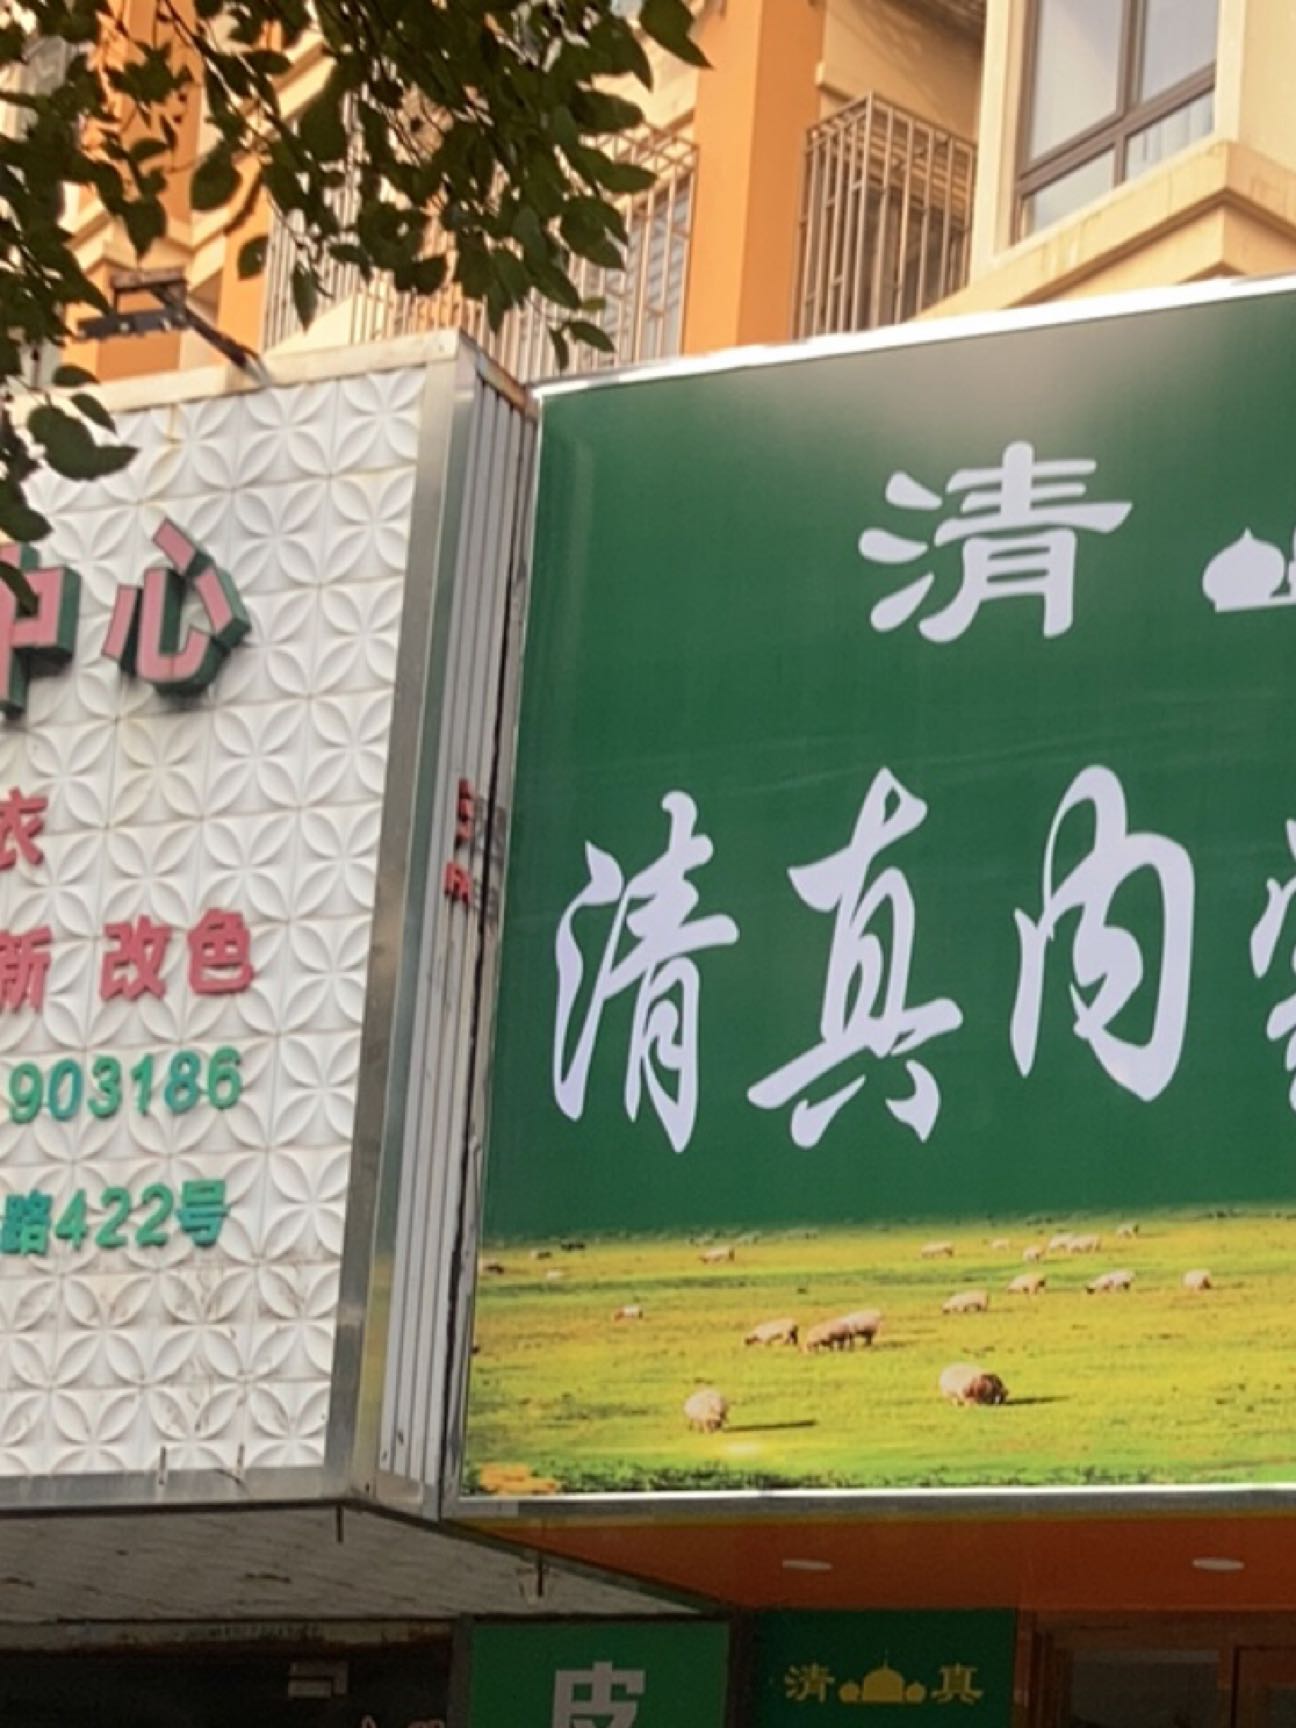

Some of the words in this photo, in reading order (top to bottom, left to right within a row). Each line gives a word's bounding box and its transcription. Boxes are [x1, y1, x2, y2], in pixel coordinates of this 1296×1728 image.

[858, 440, 1133, 644] 清
[100, 907, 255, 1000] 改色
[8, 1045, 244, 1124] 903186
[784, 1661, 835, 1704] 清
[931, 1661, 985, 1705] 真
